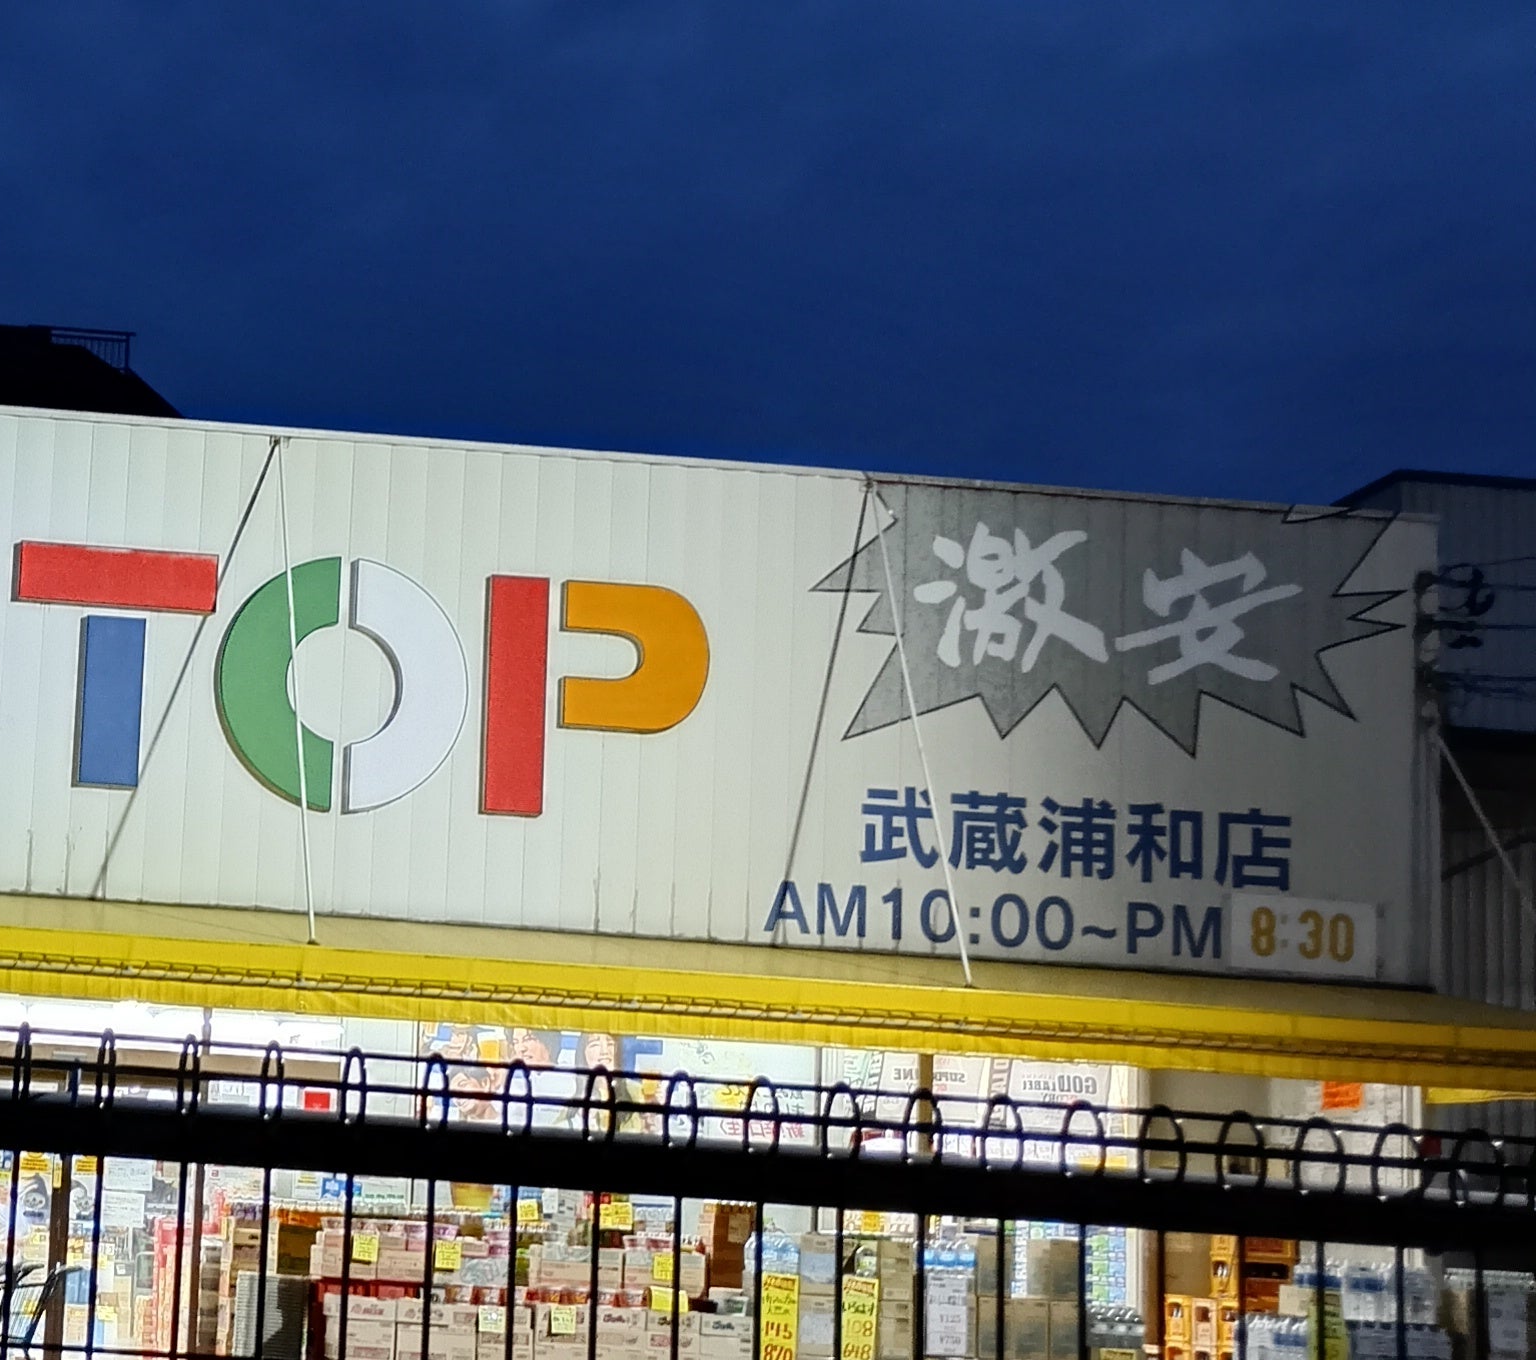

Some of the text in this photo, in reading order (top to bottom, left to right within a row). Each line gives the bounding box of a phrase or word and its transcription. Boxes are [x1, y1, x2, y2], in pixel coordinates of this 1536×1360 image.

[914, 522, 1303, 685] 激安
[859, 786, 1292, 891] 武蔵浦和店
